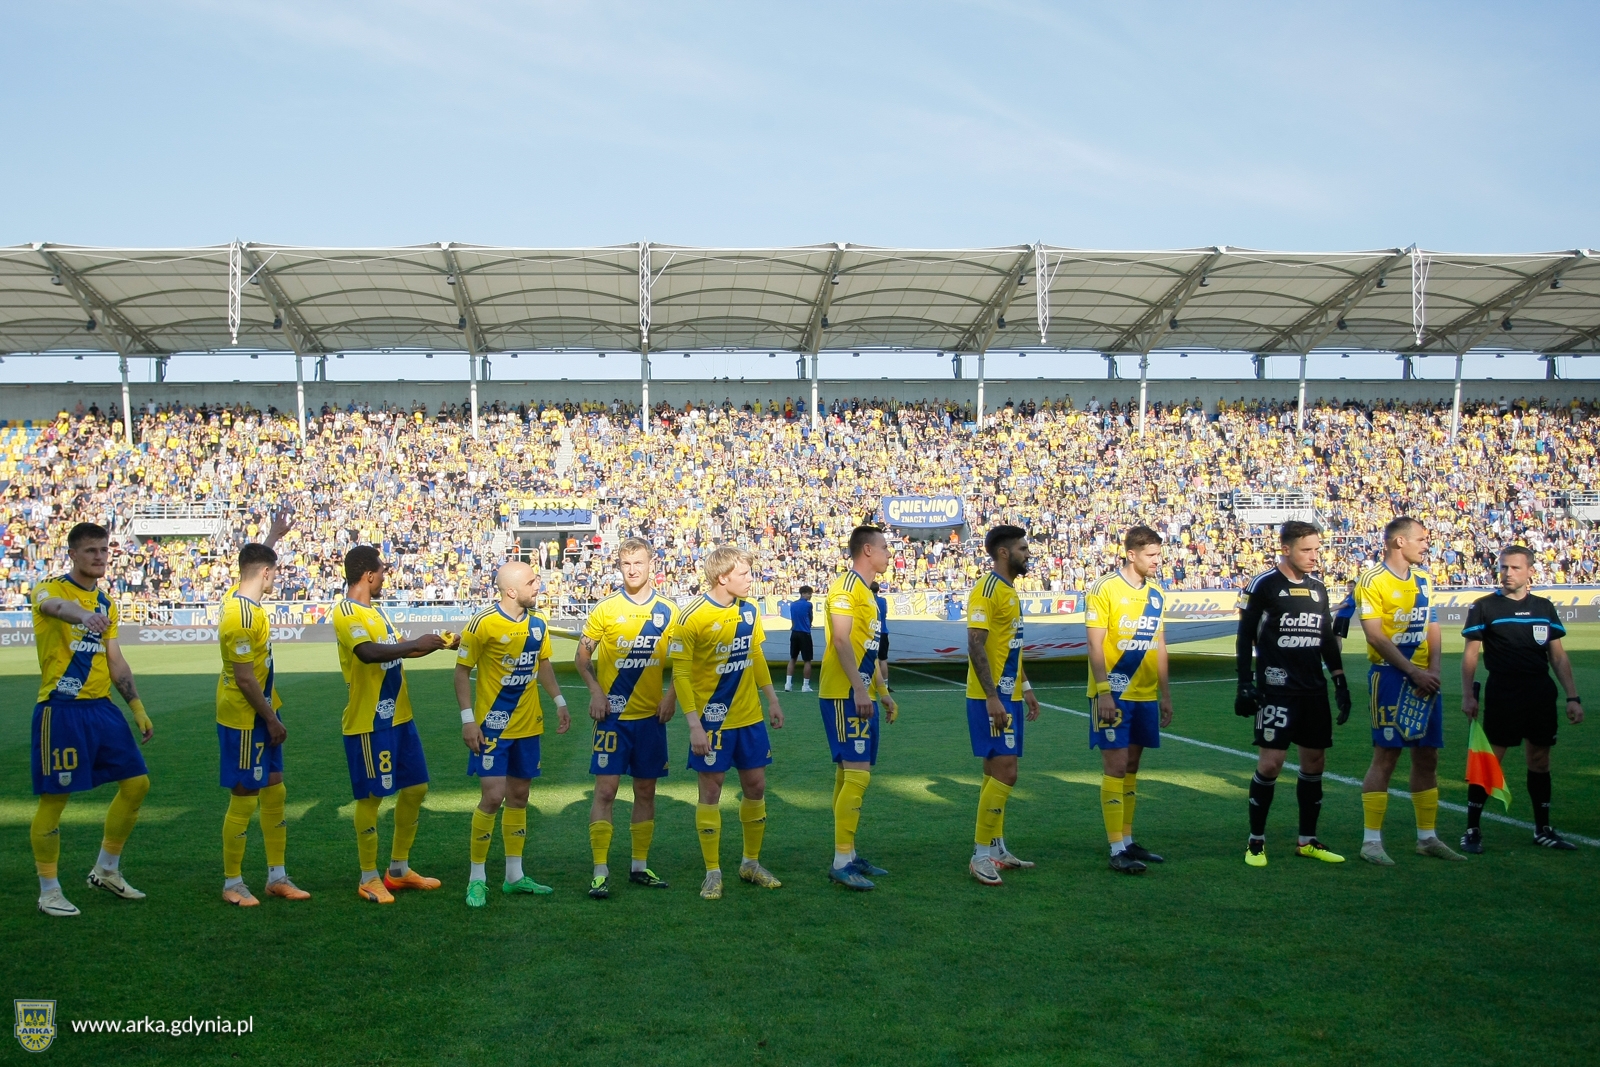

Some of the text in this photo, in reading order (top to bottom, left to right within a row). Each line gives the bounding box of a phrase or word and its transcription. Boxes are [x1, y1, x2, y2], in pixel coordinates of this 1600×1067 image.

[529, 502, 583, 517] ARKA
[889, 499, 959, 520] GNIEWINO
[929, 515, 948, 523] ARKA
[408, 613, 444, 622] Energa
[1118, 615, 1162, 630] forBET
[1279, 612, 1322, 628] forBET
[1447, 613, 1461, 621] na
[616, 635, 661, 649] forBET
[715, 635, 753, 654] forBET
[501, 650, 541, 666] forBET
[614, 658, 660, 669] GDYNIA
[1263, 705, 1288, 728] 95
[847, 717, 870, 739] 32
[593, 730, 618, 753] 20
[52, 747, 78, 770] 10
[255, 742, 265, 765] 7
[379, 750, 392, 773] 8
